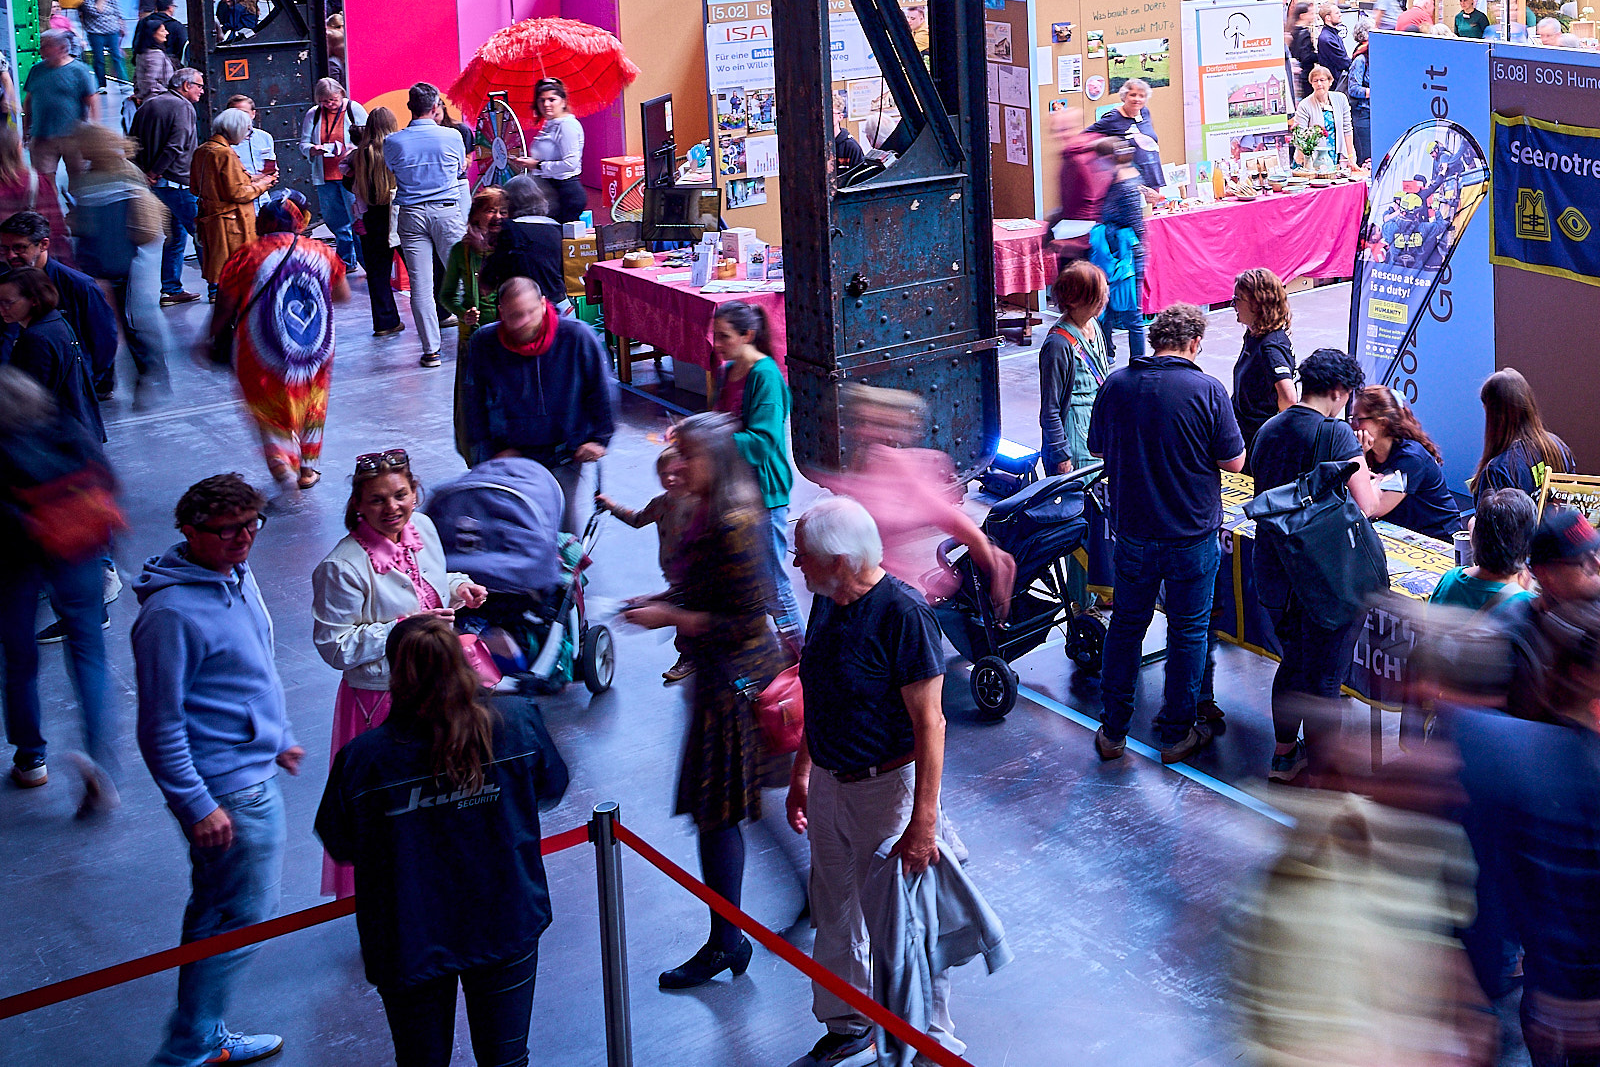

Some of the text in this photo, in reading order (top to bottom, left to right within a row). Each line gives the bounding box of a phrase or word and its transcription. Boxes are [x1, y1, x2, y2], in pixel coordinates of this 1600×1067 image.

[711, 4, 749, 20] [5.02]
[726, 25, 769, 42] ISA
[715, 51, 749, 62] Für eine
[715, 61, 768, 72] Wo ein Wille
[1492, 62, 1528, 83] [5.08]
[1535, 68, 1564, 86] SOS
[568, 244, 576, 258] 2
[1371, 268, 1431, 287] Rescue at sea
[1370, 280, 1411, 299] is a duty!
[457, 793, 500, 810] SECURITY
